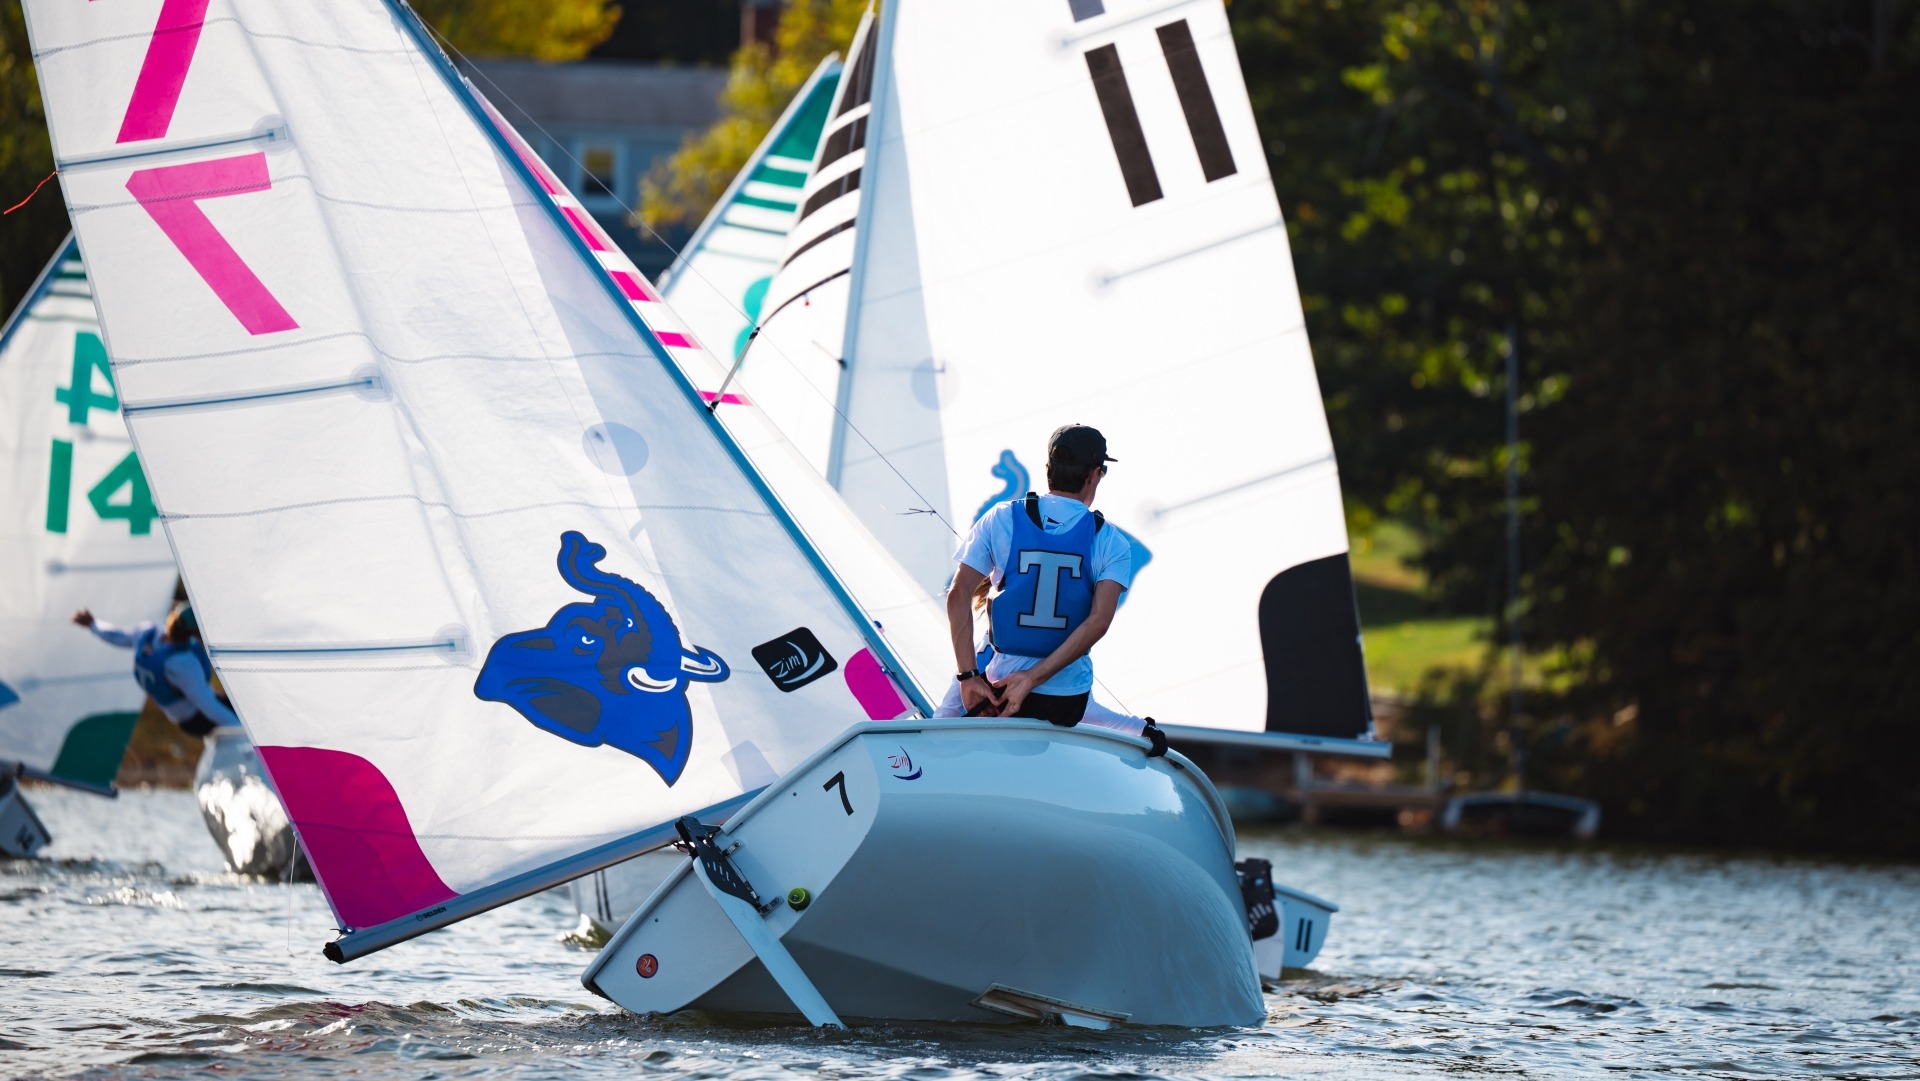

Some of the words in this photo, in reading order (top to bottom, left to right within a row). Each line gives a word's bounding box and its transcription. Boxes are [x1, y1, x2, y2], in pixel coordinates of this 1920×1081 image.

[1084, 18, 1238, 208] 11
[46, 439, 160, 535] 14
[1018, 549, 1083, 629] T
[823, 771, 854, 816] 7
[1296, 918, 1312, 953] 11
